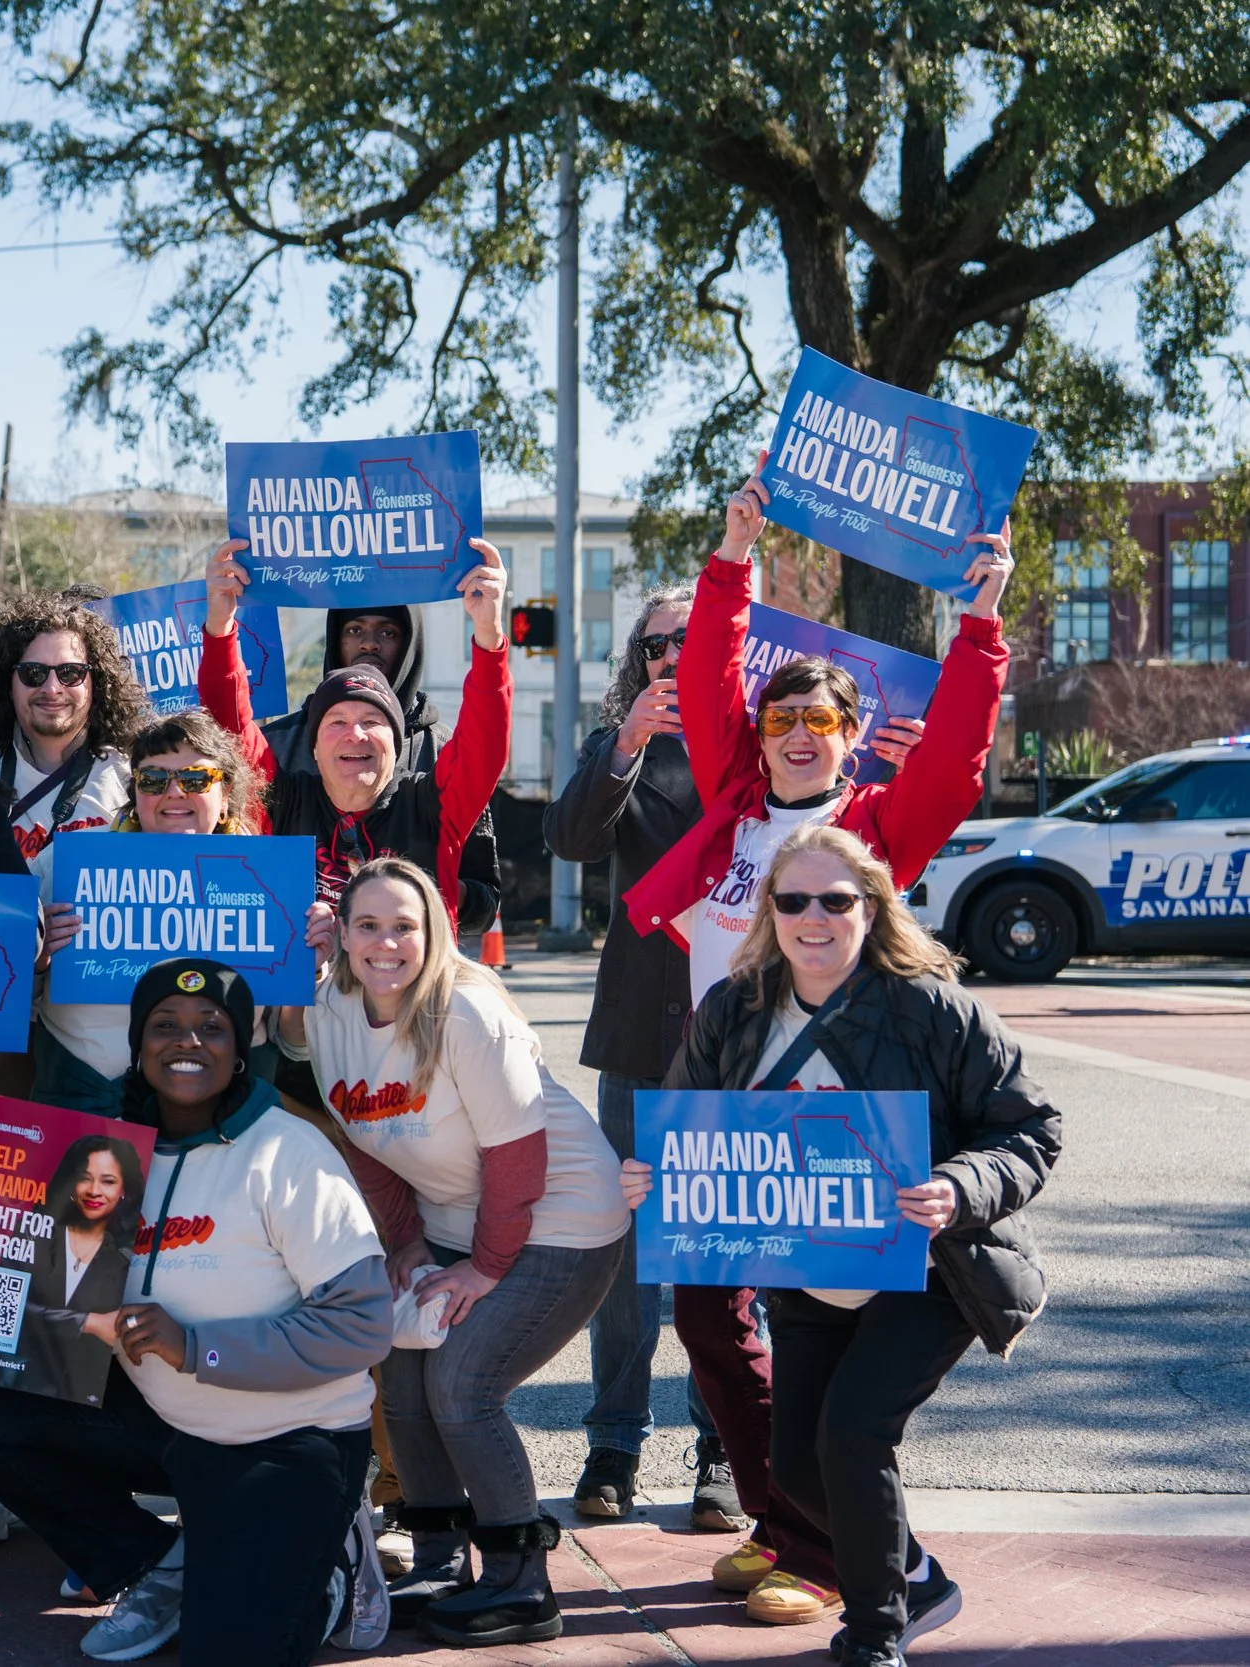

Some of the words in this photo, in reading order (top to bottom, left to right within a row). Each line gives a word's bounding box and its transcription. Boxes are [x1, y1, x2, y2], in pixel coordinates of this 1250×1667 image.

[792, 390, 899, 463] AMANDA
[904, 444, 922, 461] for
[777, 427, 960, 537] HOLLOWELL
[905, 457, 965, 488] CONGRESS
[247, 476, 363, 513] AMANDA
[372, 485, 387, 499] for
[375, 493, 432, 510] CONGRESS
[771, 477, 794, 502] The
[794, 489, 839, 520] People
[839, 507, 884, 533] First
[249, 509, 445, 558] HOLLOWELL
[254, 565, 282, 585] The
[282, 565, 330, 588] People
[332, 565, 375, 586] First
[116, 616, 181, 656] ANDA
[187, 623, 200, 637] for
[74, 868, 197, 905] AMANDA
[205, 881, 219, 897] for
[208, 892, 265, 907] CONGRESS
[1121, 899, 1250, 918] SAVANNA
[76, 906, 275, 953] HOLLOWELL
[75, 959, 105, 980] The
[106, 958, 150, 982] Peopl
[660, 1131, 795, 1173] AMANDA
[805, 1145, 821, 1159] for
[808, 1159, 872, 1174] CONGRESS
[662, 1174, 886, 1229] HOLLOWELL
[20, 1209, 55, 1239] FOR
[662, 1233, 697, 1257] The
[698, 1233, 756, 1261] People
[756, 1235, 804, 1258] First
